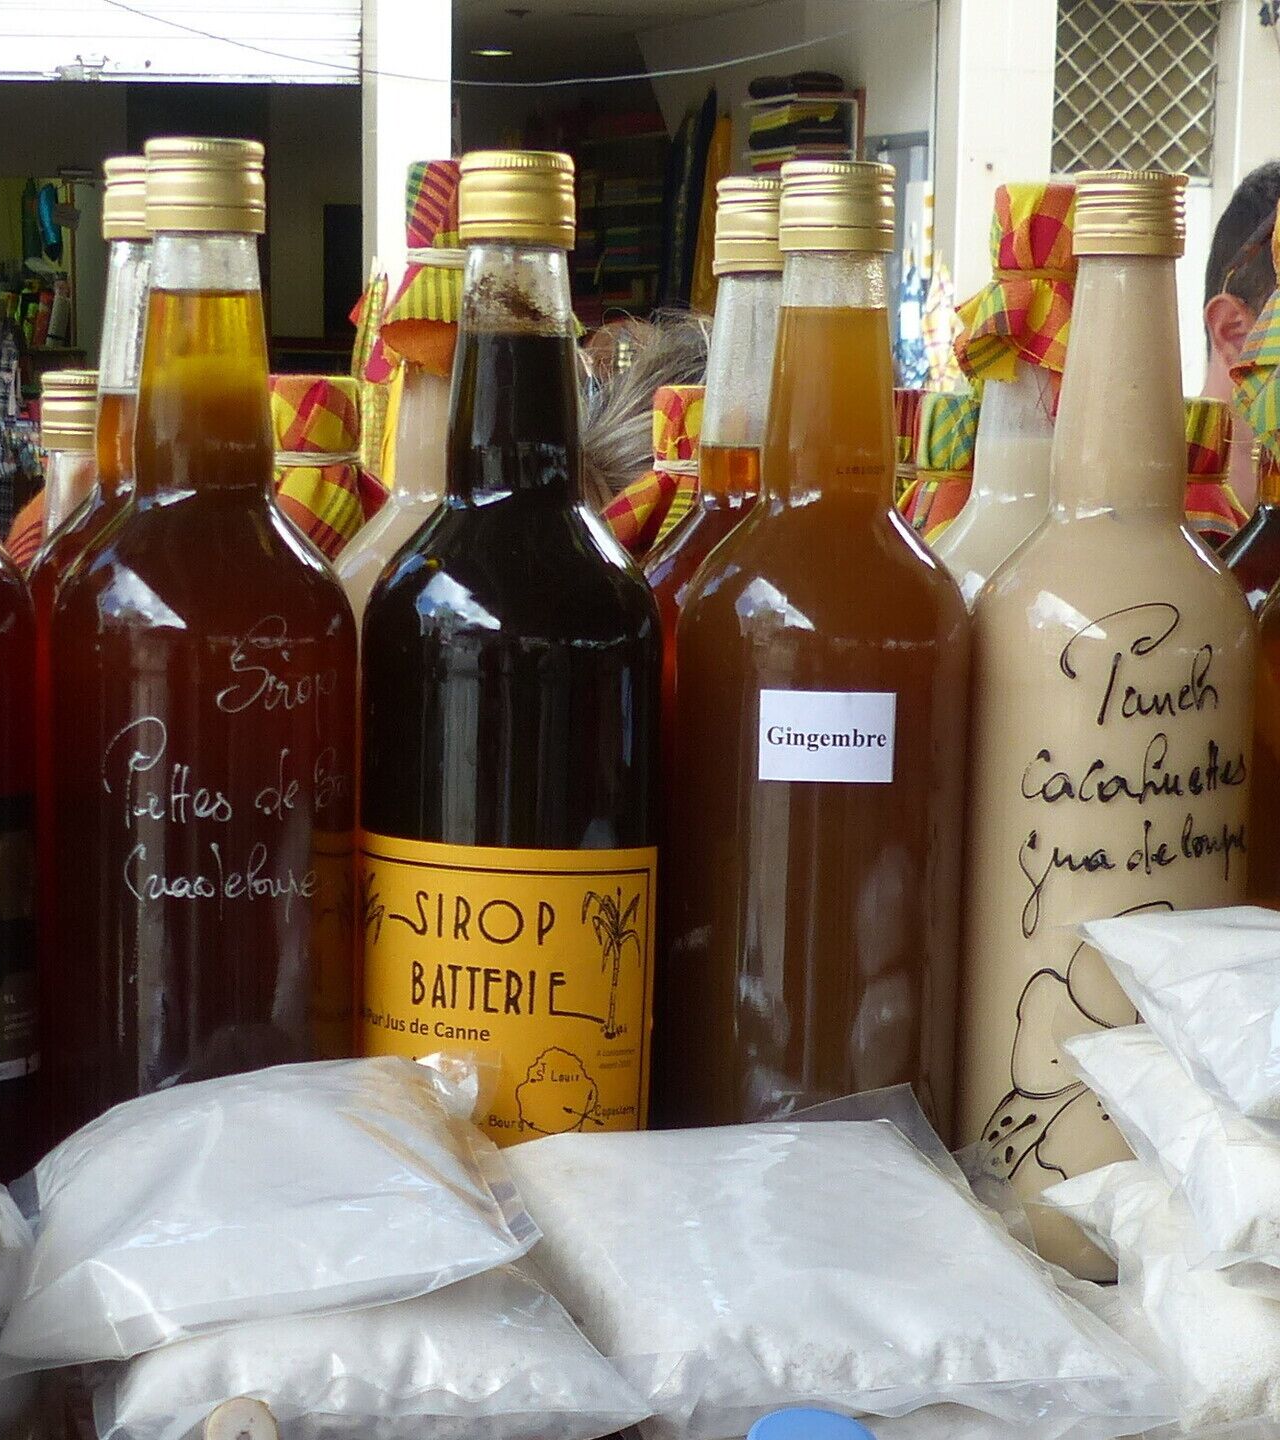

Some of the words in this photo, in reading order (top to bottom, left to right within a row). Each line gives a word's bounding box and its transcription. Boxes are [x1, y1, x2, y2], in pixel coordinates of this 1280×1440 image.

[767, 725, 888, 751] Gingembre
[388, 889, 556, 945] SIROP
[410, 960, 606, 1024] BATTERIE
[384, 1013, 406, 1032] Jus
[409, 1018, 429, 1036] de
[434, 1022, 491, 1042] Canne
